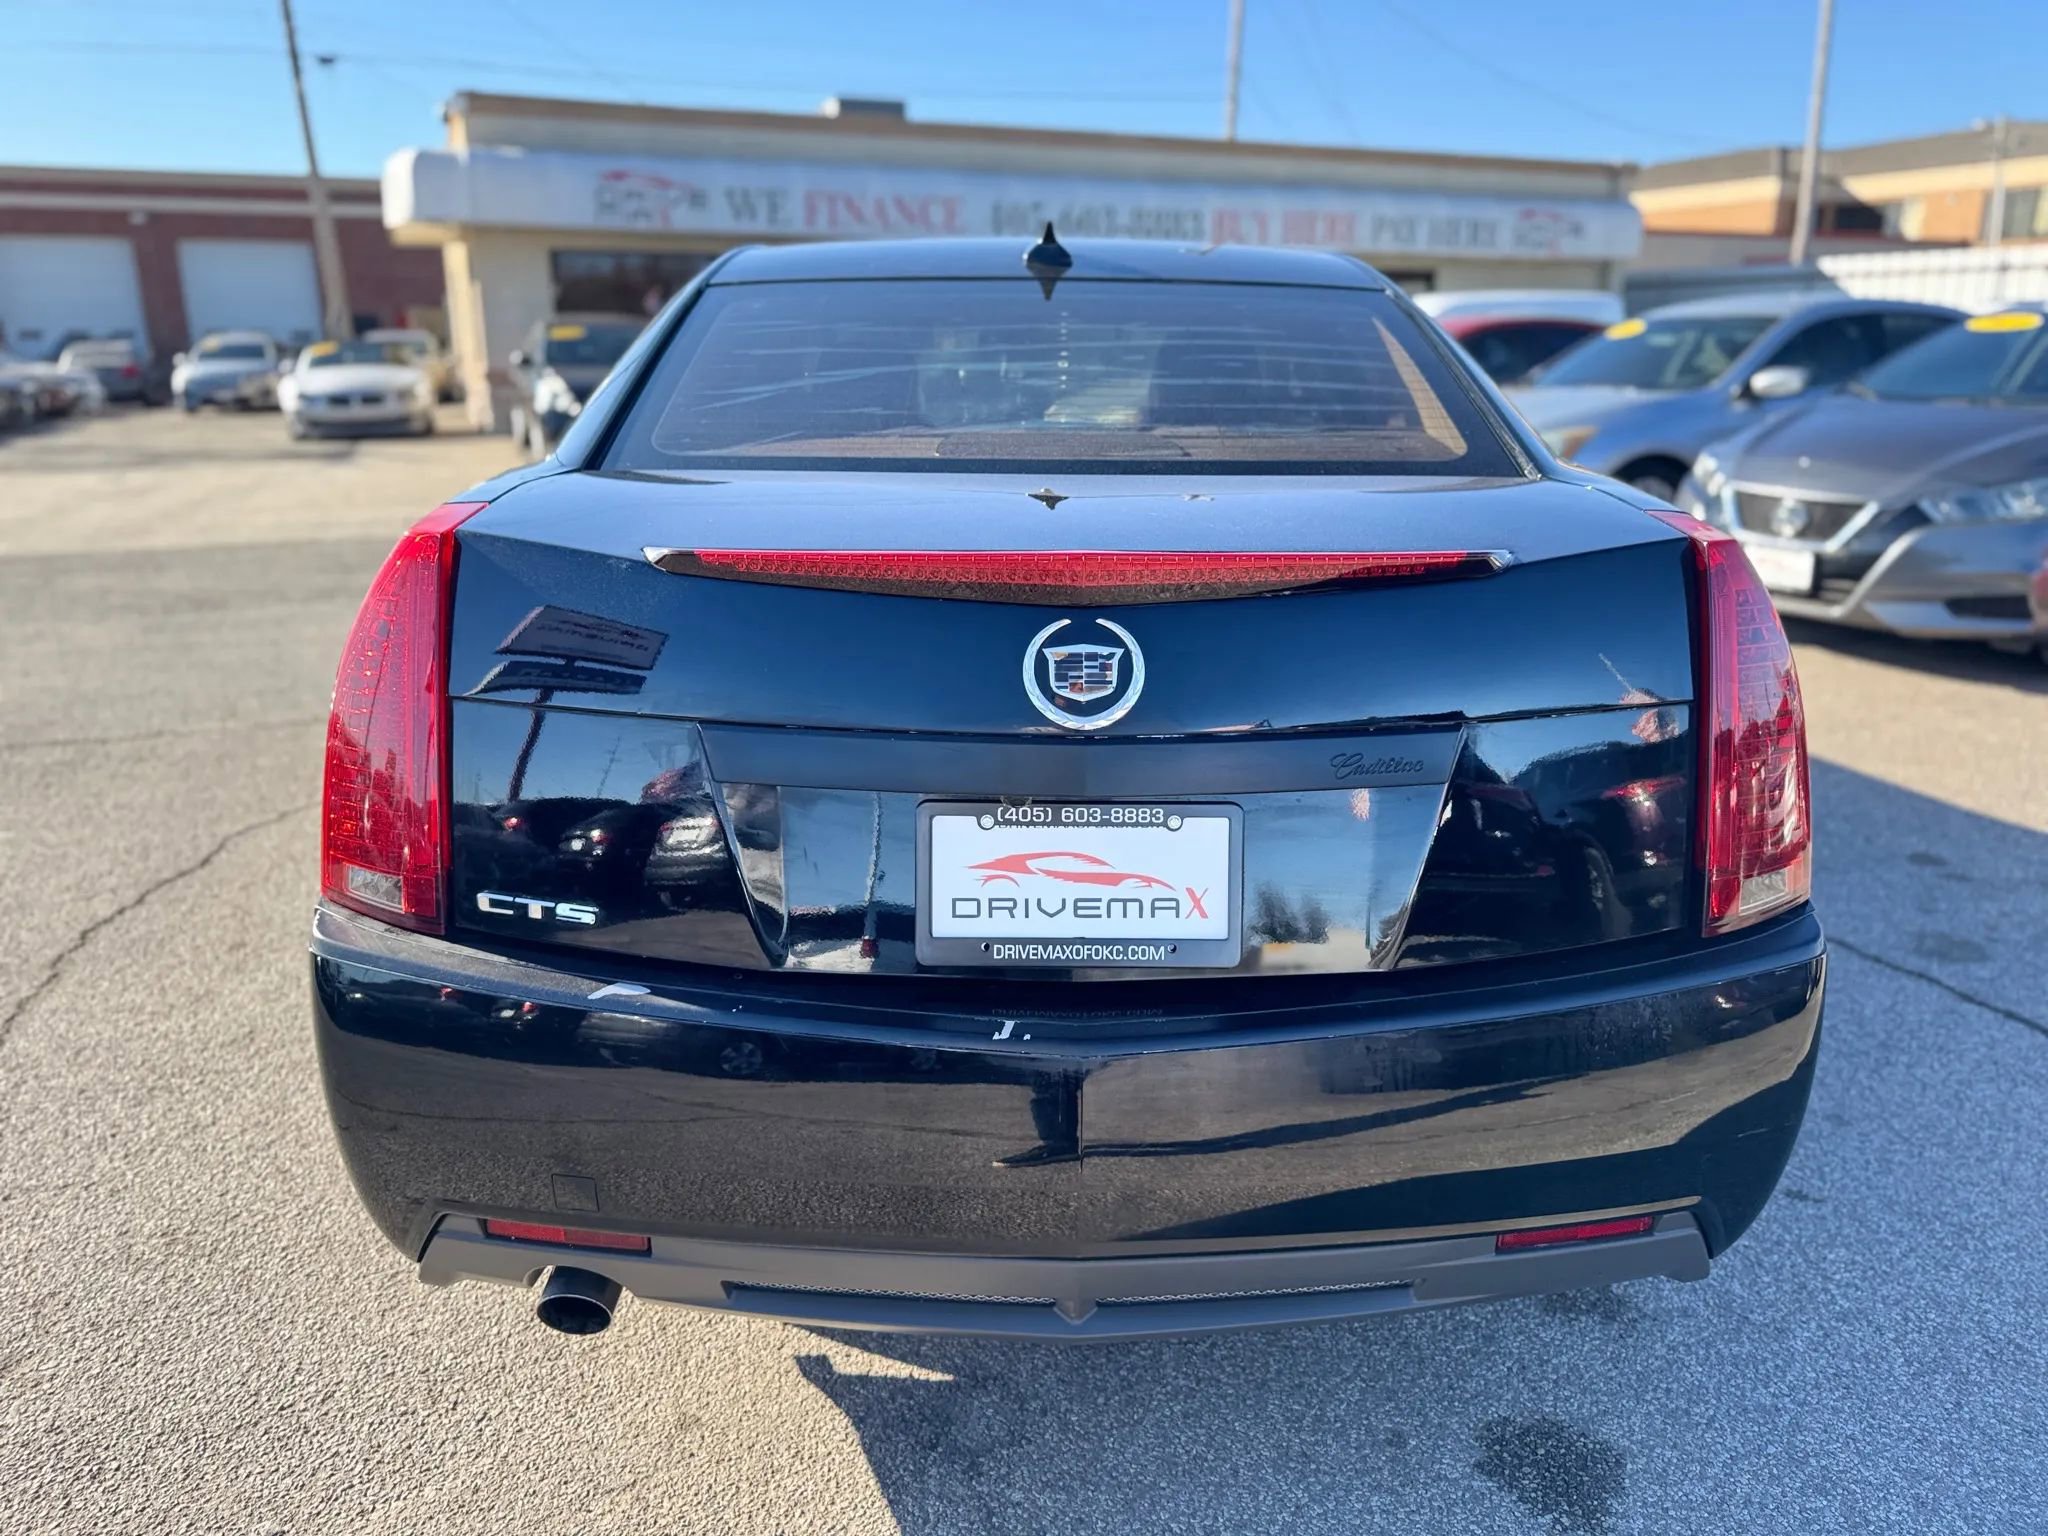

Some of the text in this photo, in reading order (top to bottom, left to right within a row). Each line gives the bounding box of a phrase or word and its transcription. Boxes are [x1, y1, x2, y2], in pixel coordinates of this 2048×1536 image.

[724, 185, 791, 228] WE
[803, 188, 966, 234] FINANCE
[1330, 752, 1424, 780] Cadillac
[997, 807, 1164, 823] (405) 603-8883
[476, 889, 600, 925] CTS
[951, 887, 1209, 919] DRIVEMAX
[993, 944, 1165, 961] DRIVEMAXOFOKC.COM
